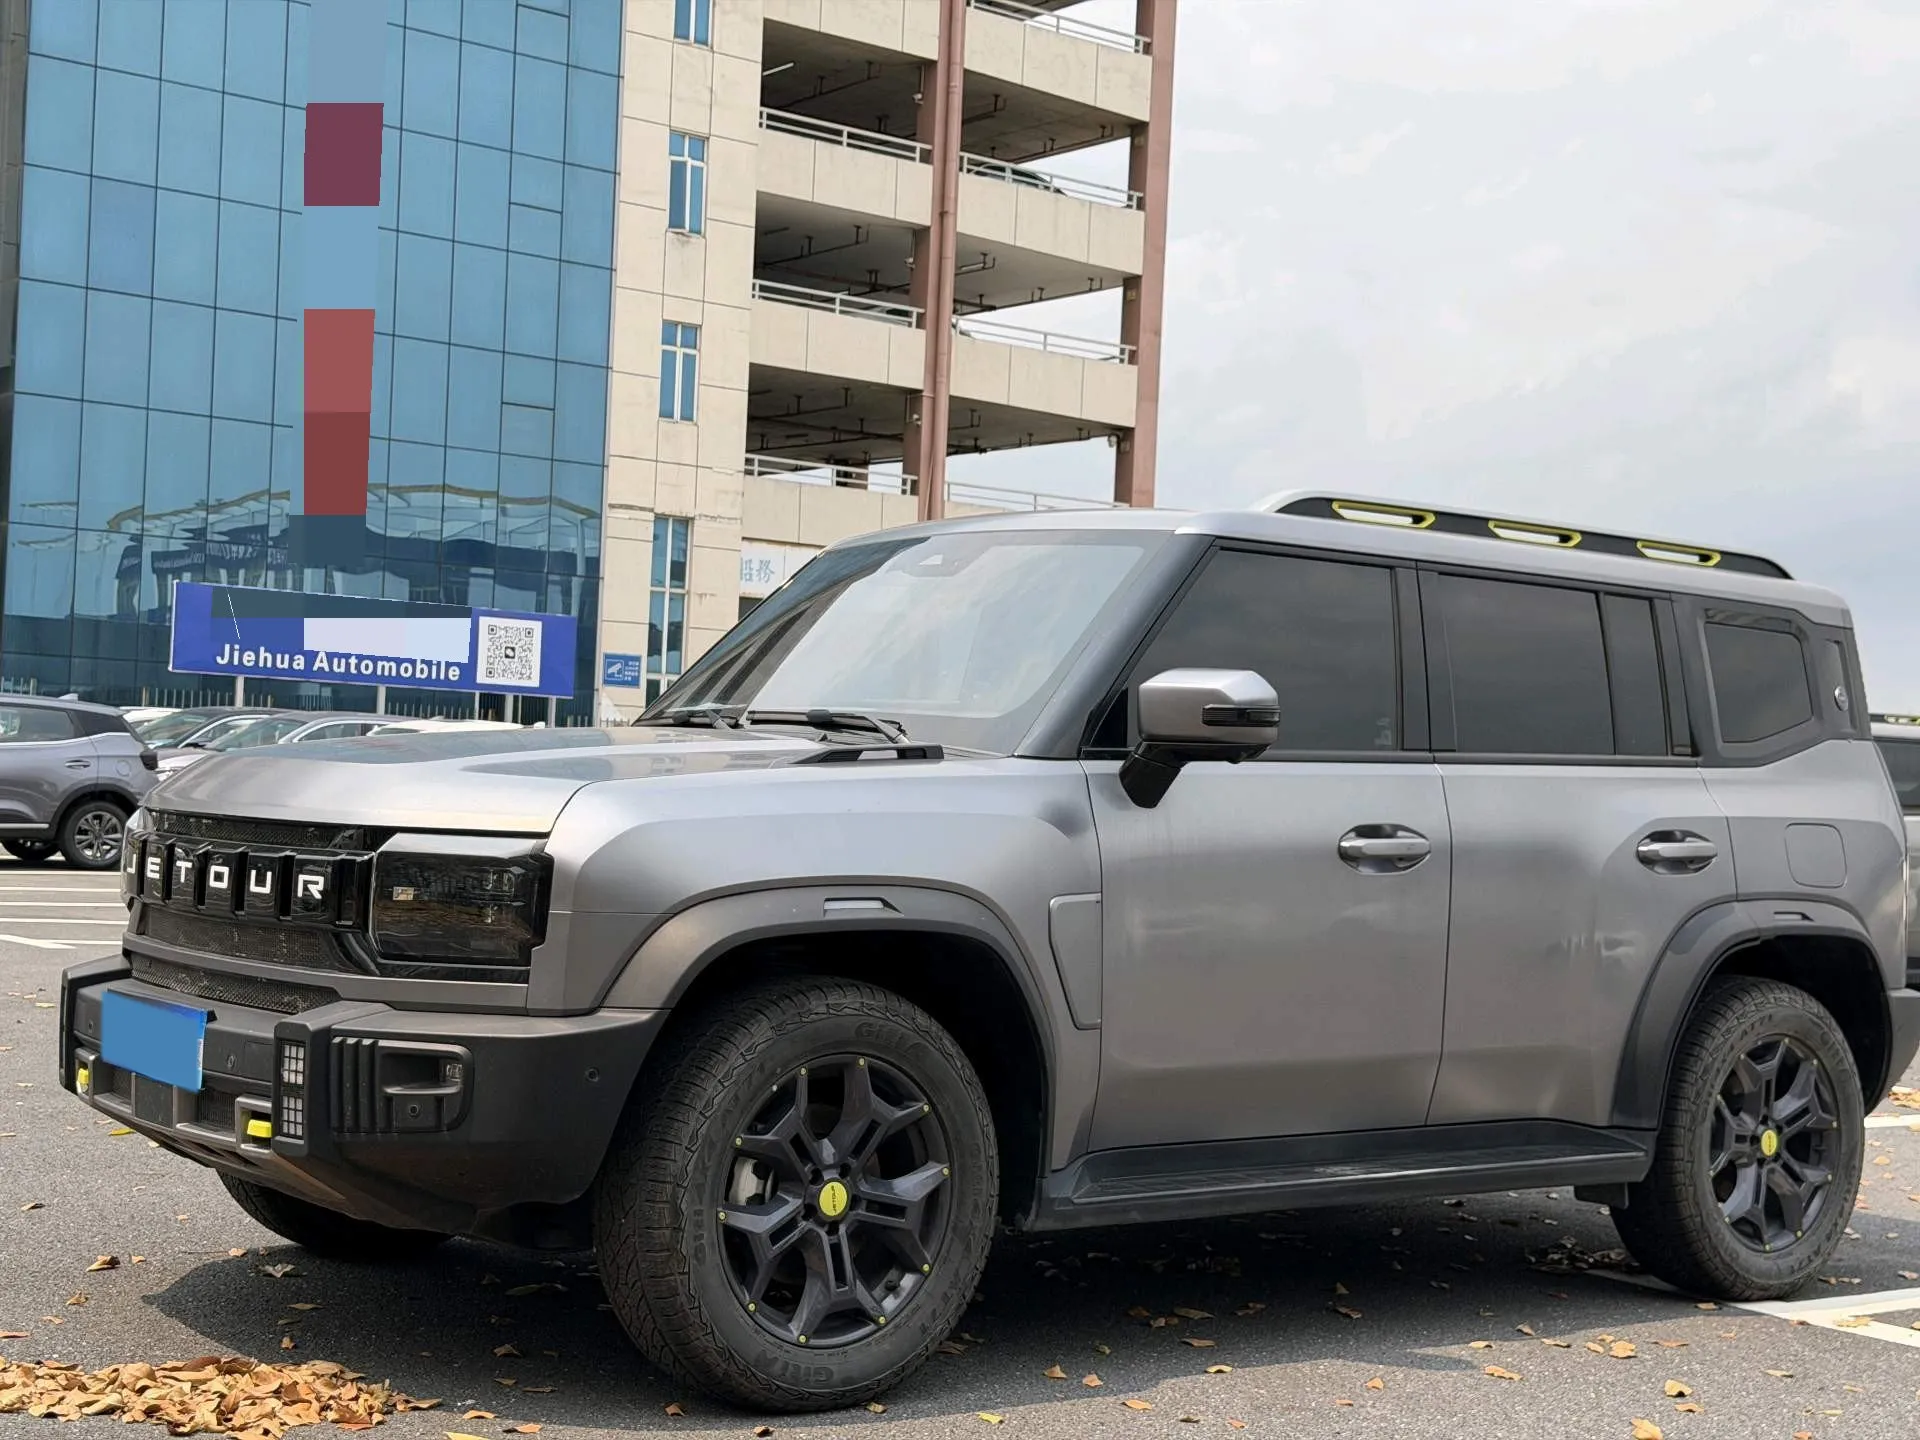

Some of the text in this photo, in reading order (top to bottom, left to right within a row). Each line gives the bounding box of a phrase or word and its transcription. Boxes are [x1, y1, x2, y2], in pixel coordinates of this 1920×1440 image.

[216, 643, 461, 681] Jiehua Automobile
[126, 853, 325, 900] JETOUR
